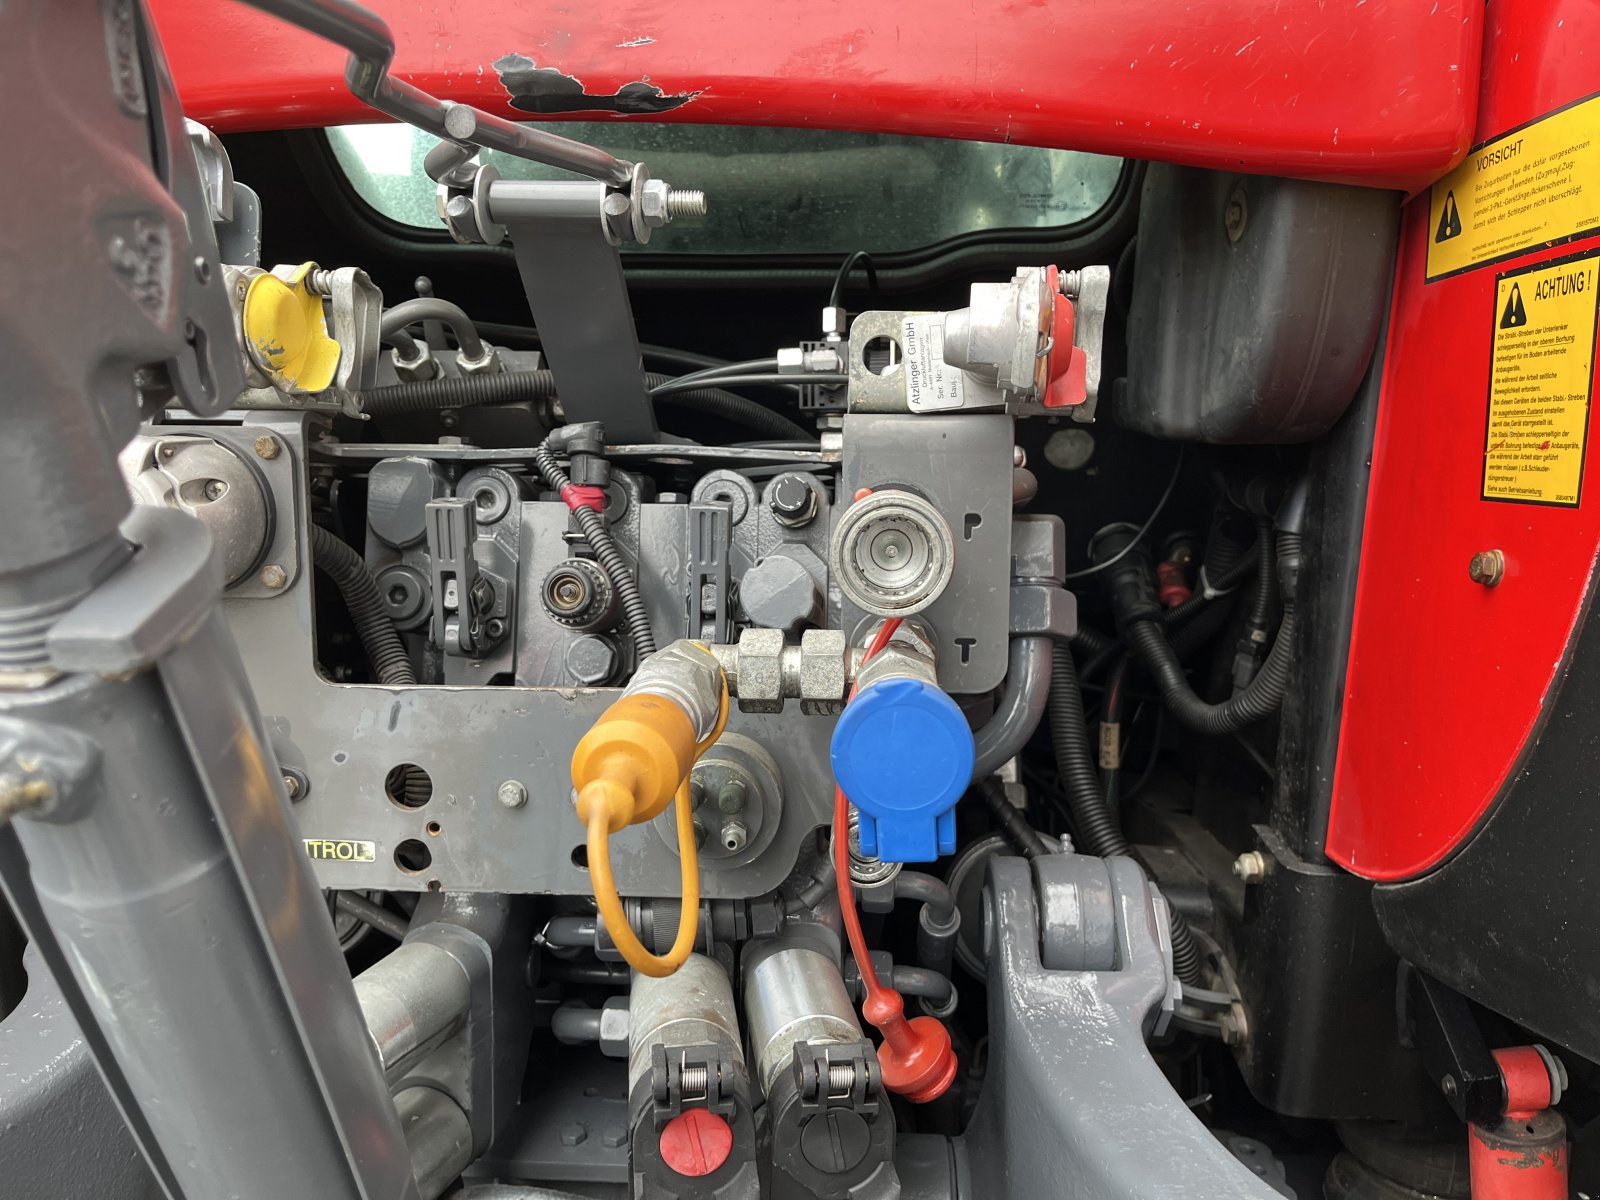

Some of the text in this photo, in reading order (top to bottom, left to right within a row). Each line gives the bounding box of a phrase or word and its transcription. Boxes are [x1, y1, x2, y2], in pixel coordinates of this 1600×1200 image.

[1477, 138, 1523, 171] VORSICHT
[1512, 168, 1520, 176] nur
[1497, 213, 1505, 221] der
[1533, 197, 1546, 208] nicht
[1534, 271, 1584, 301] ACHTUNG
[906, 322, 920, 404] Atzlinger GmbH
[1567, 393, 1585, 401] Streben
[964, 513, 982, 541] P
[954, 638, 977, 664] T
[304, 840, 364, 860] TROL
